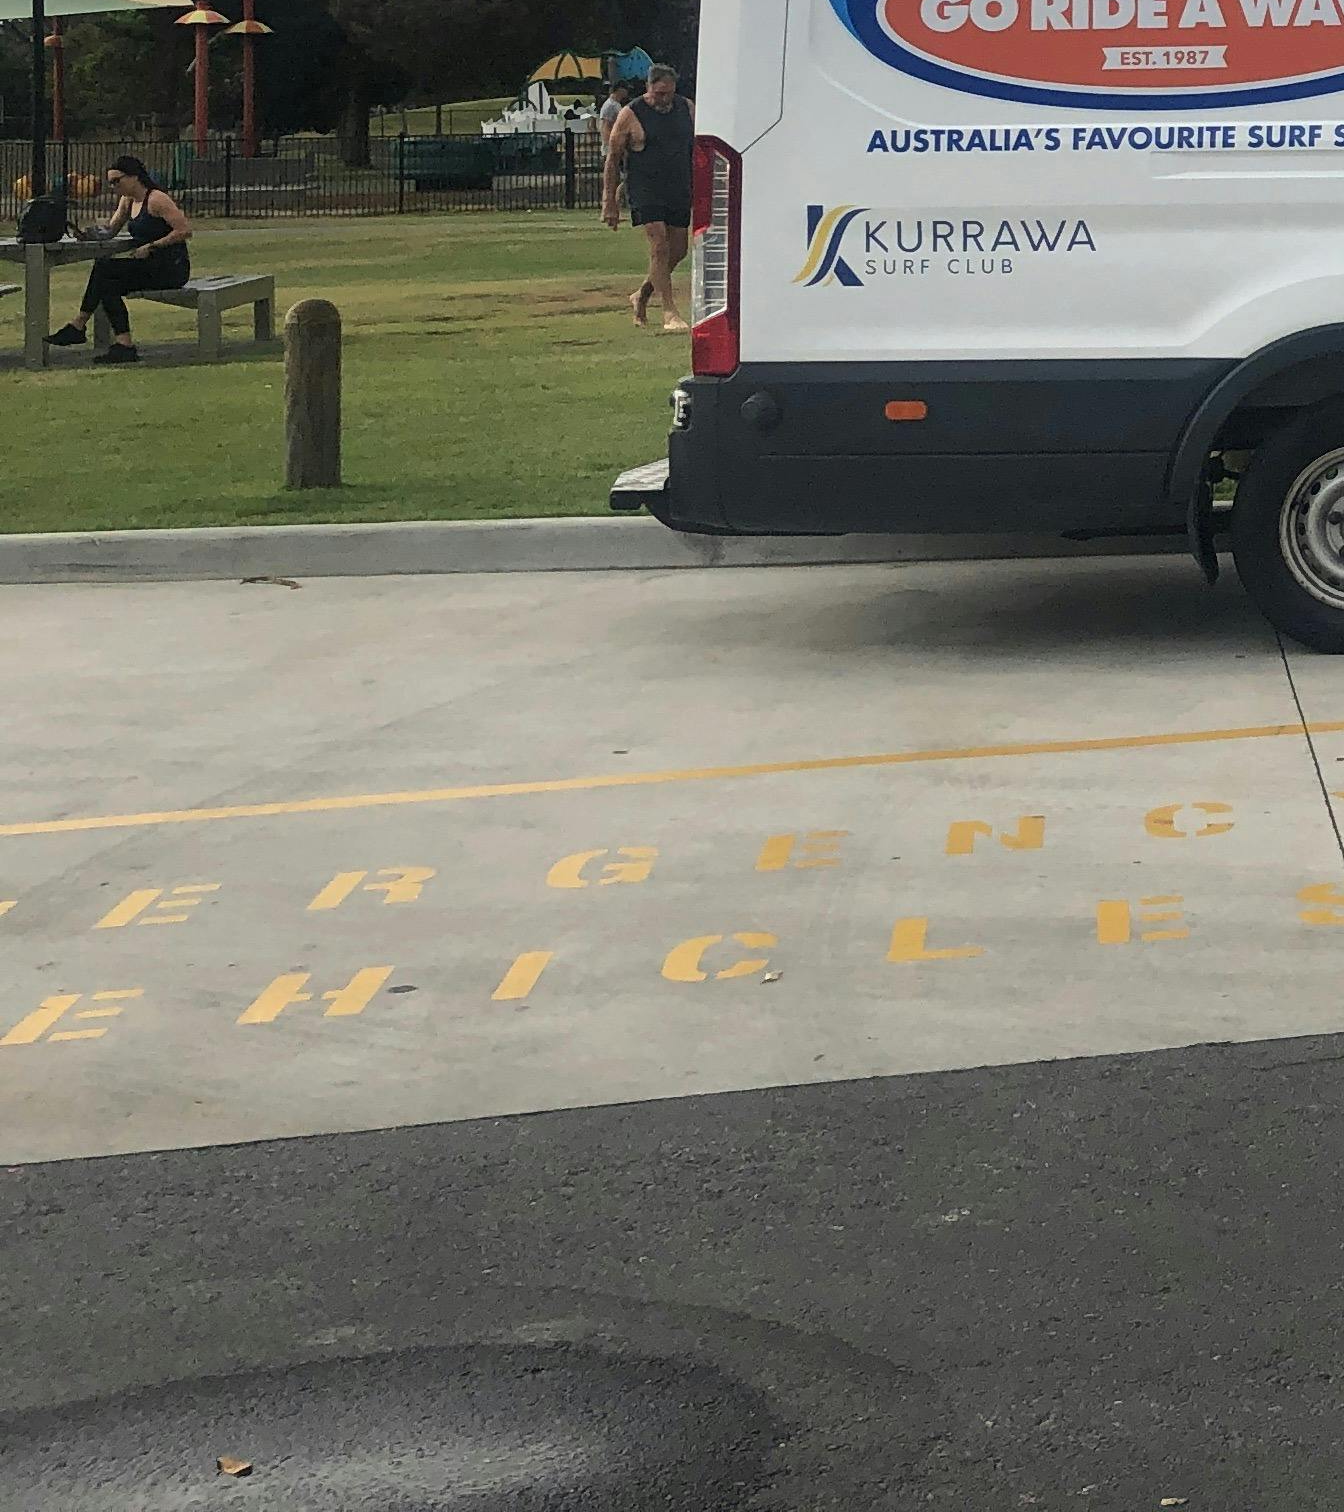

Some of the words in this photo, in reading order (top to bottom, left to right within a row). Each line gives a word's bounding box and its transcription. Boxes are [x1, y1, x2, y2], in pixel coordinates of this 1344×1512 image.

[1119, 51, 1160, 67] EST.
[1162, 49, 1211, 66] 1987
[866, 127, 1061, 153] AUSTRALIA'S
[1072, 125, 1236, 151] FAVOURITE
[1247, 124, 1323, 149] SURF
[865, 219, 1097, 253] KURRAWA
[864, 258, 931, 275] SURF
[947, 258, 1014, 275] CLUB
